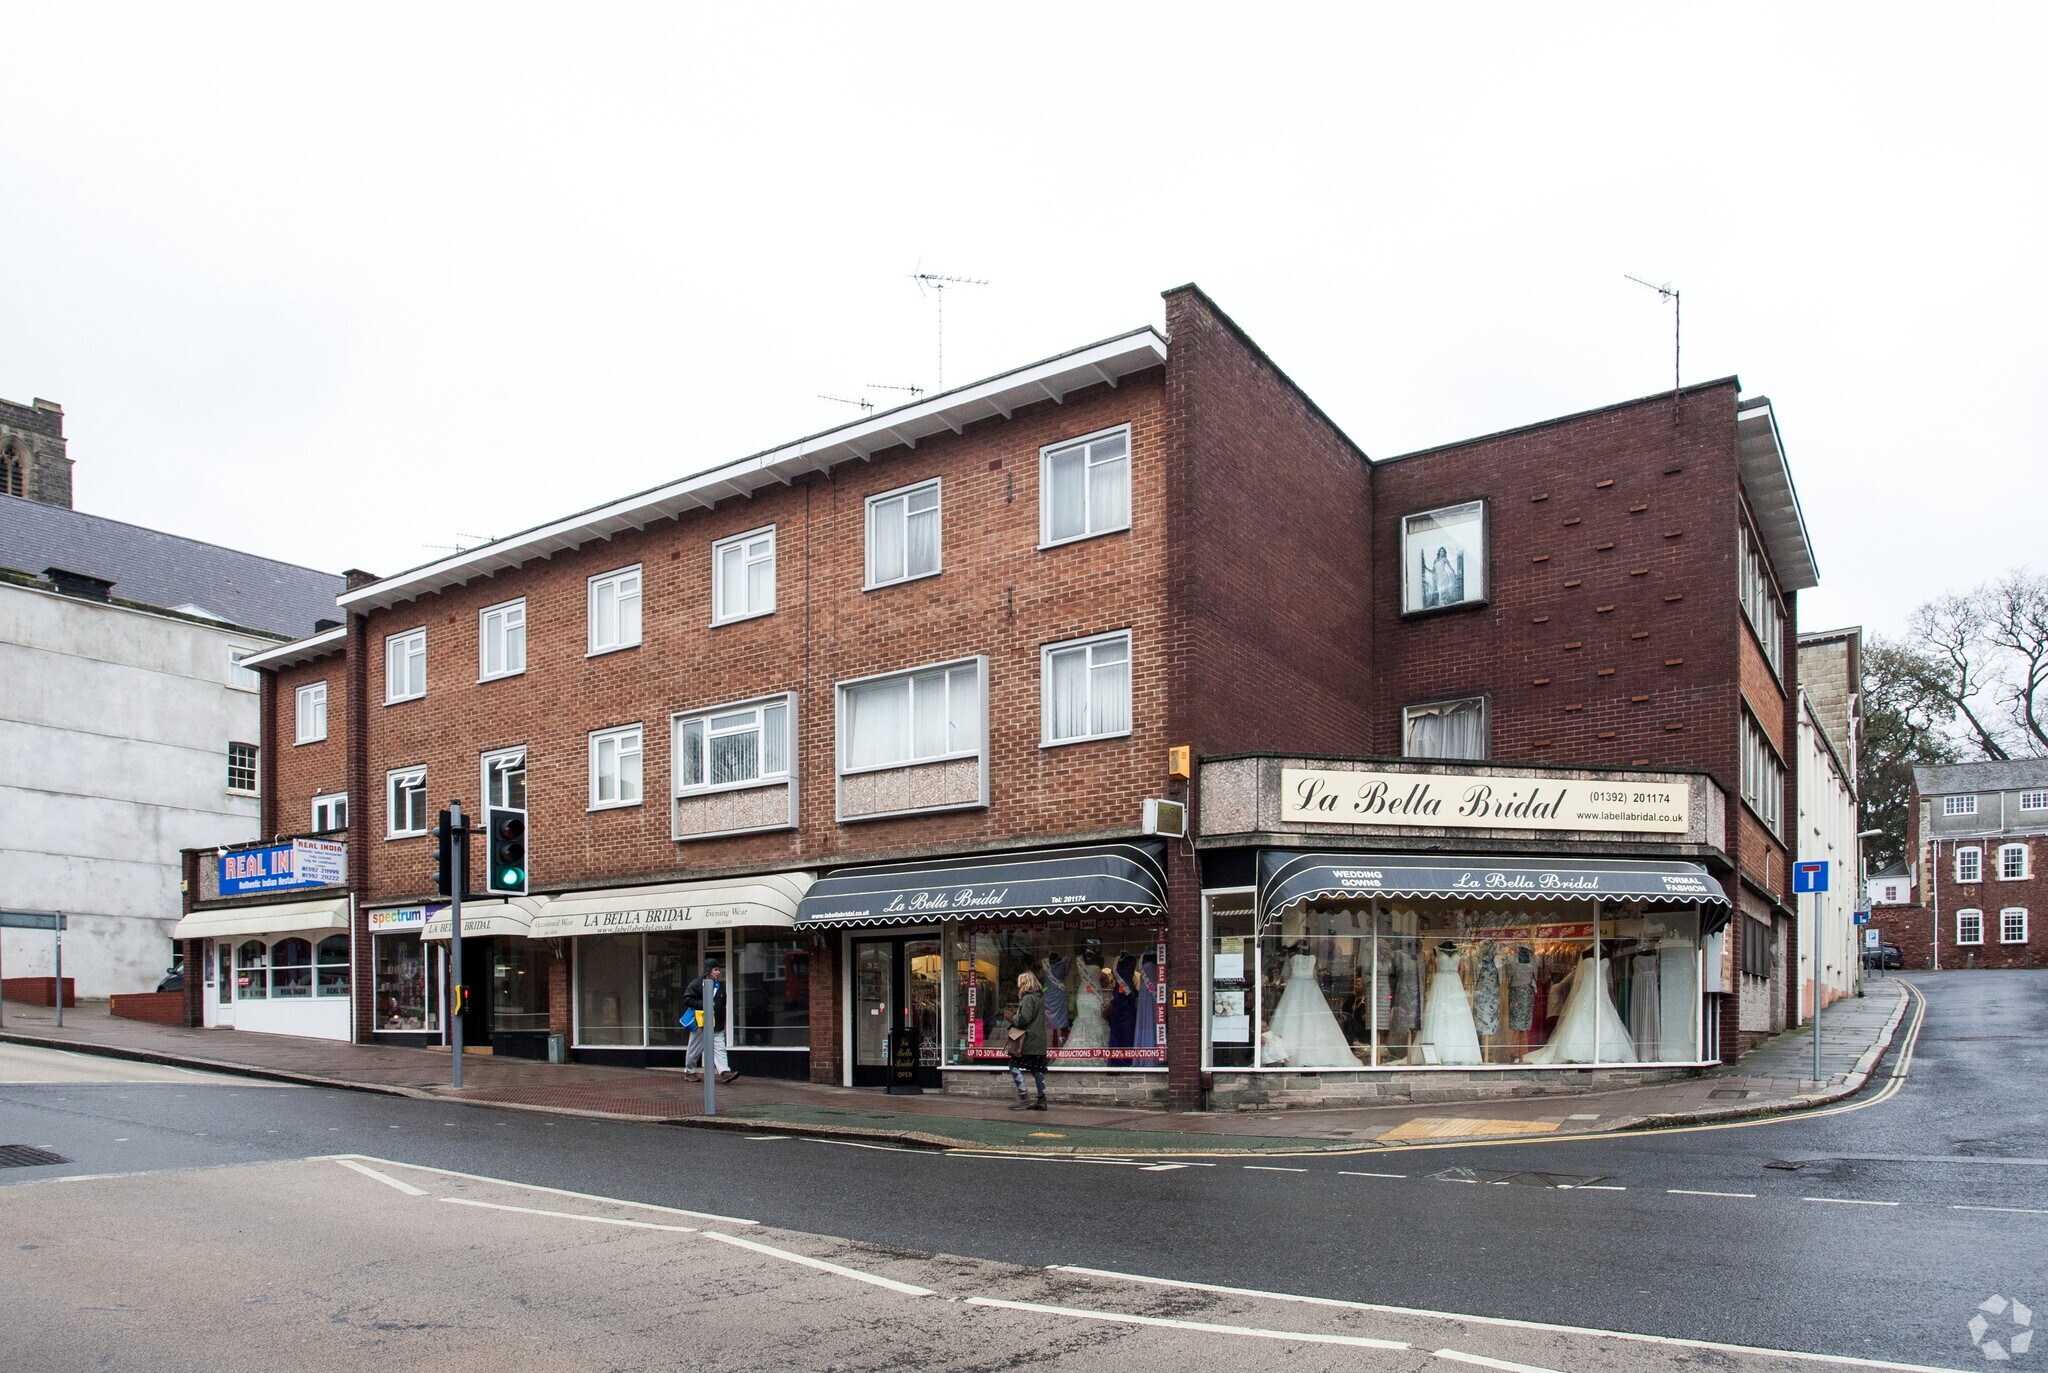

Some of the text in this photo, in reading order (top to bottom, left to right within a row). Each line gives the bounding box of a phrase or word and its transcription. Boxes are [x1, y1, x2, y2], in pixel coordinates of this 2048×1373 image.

[1292, 777, 1568, 819] La Bella Bridal
[1590, 792, 1670, 804] (01392) 201174
[1576, 811, 1683, 822] www.labellabridal.co.uk
[298, 841, 342, 852] REAL INDIA
[225, 854, 266, 880] REAL
[1332, 870, 1382, 879] WEDDING
[1452, 872, 1599, 889] La Bella Bridal
[238, 880, 261, 890] Authentic
[262, 879, 278, 888] Indian
[883, 888, 1008, 912] La Bella Bridal
[373, 909, 421, 928] spectrum
[584, 907, 692, 927] LA BELLA BRIDAL
[706, 907, 748, 917] Evening Wear
[428, 920, 492, 933] LA BEL BRIDAL
[1174, 991, 1186, 1006] H
